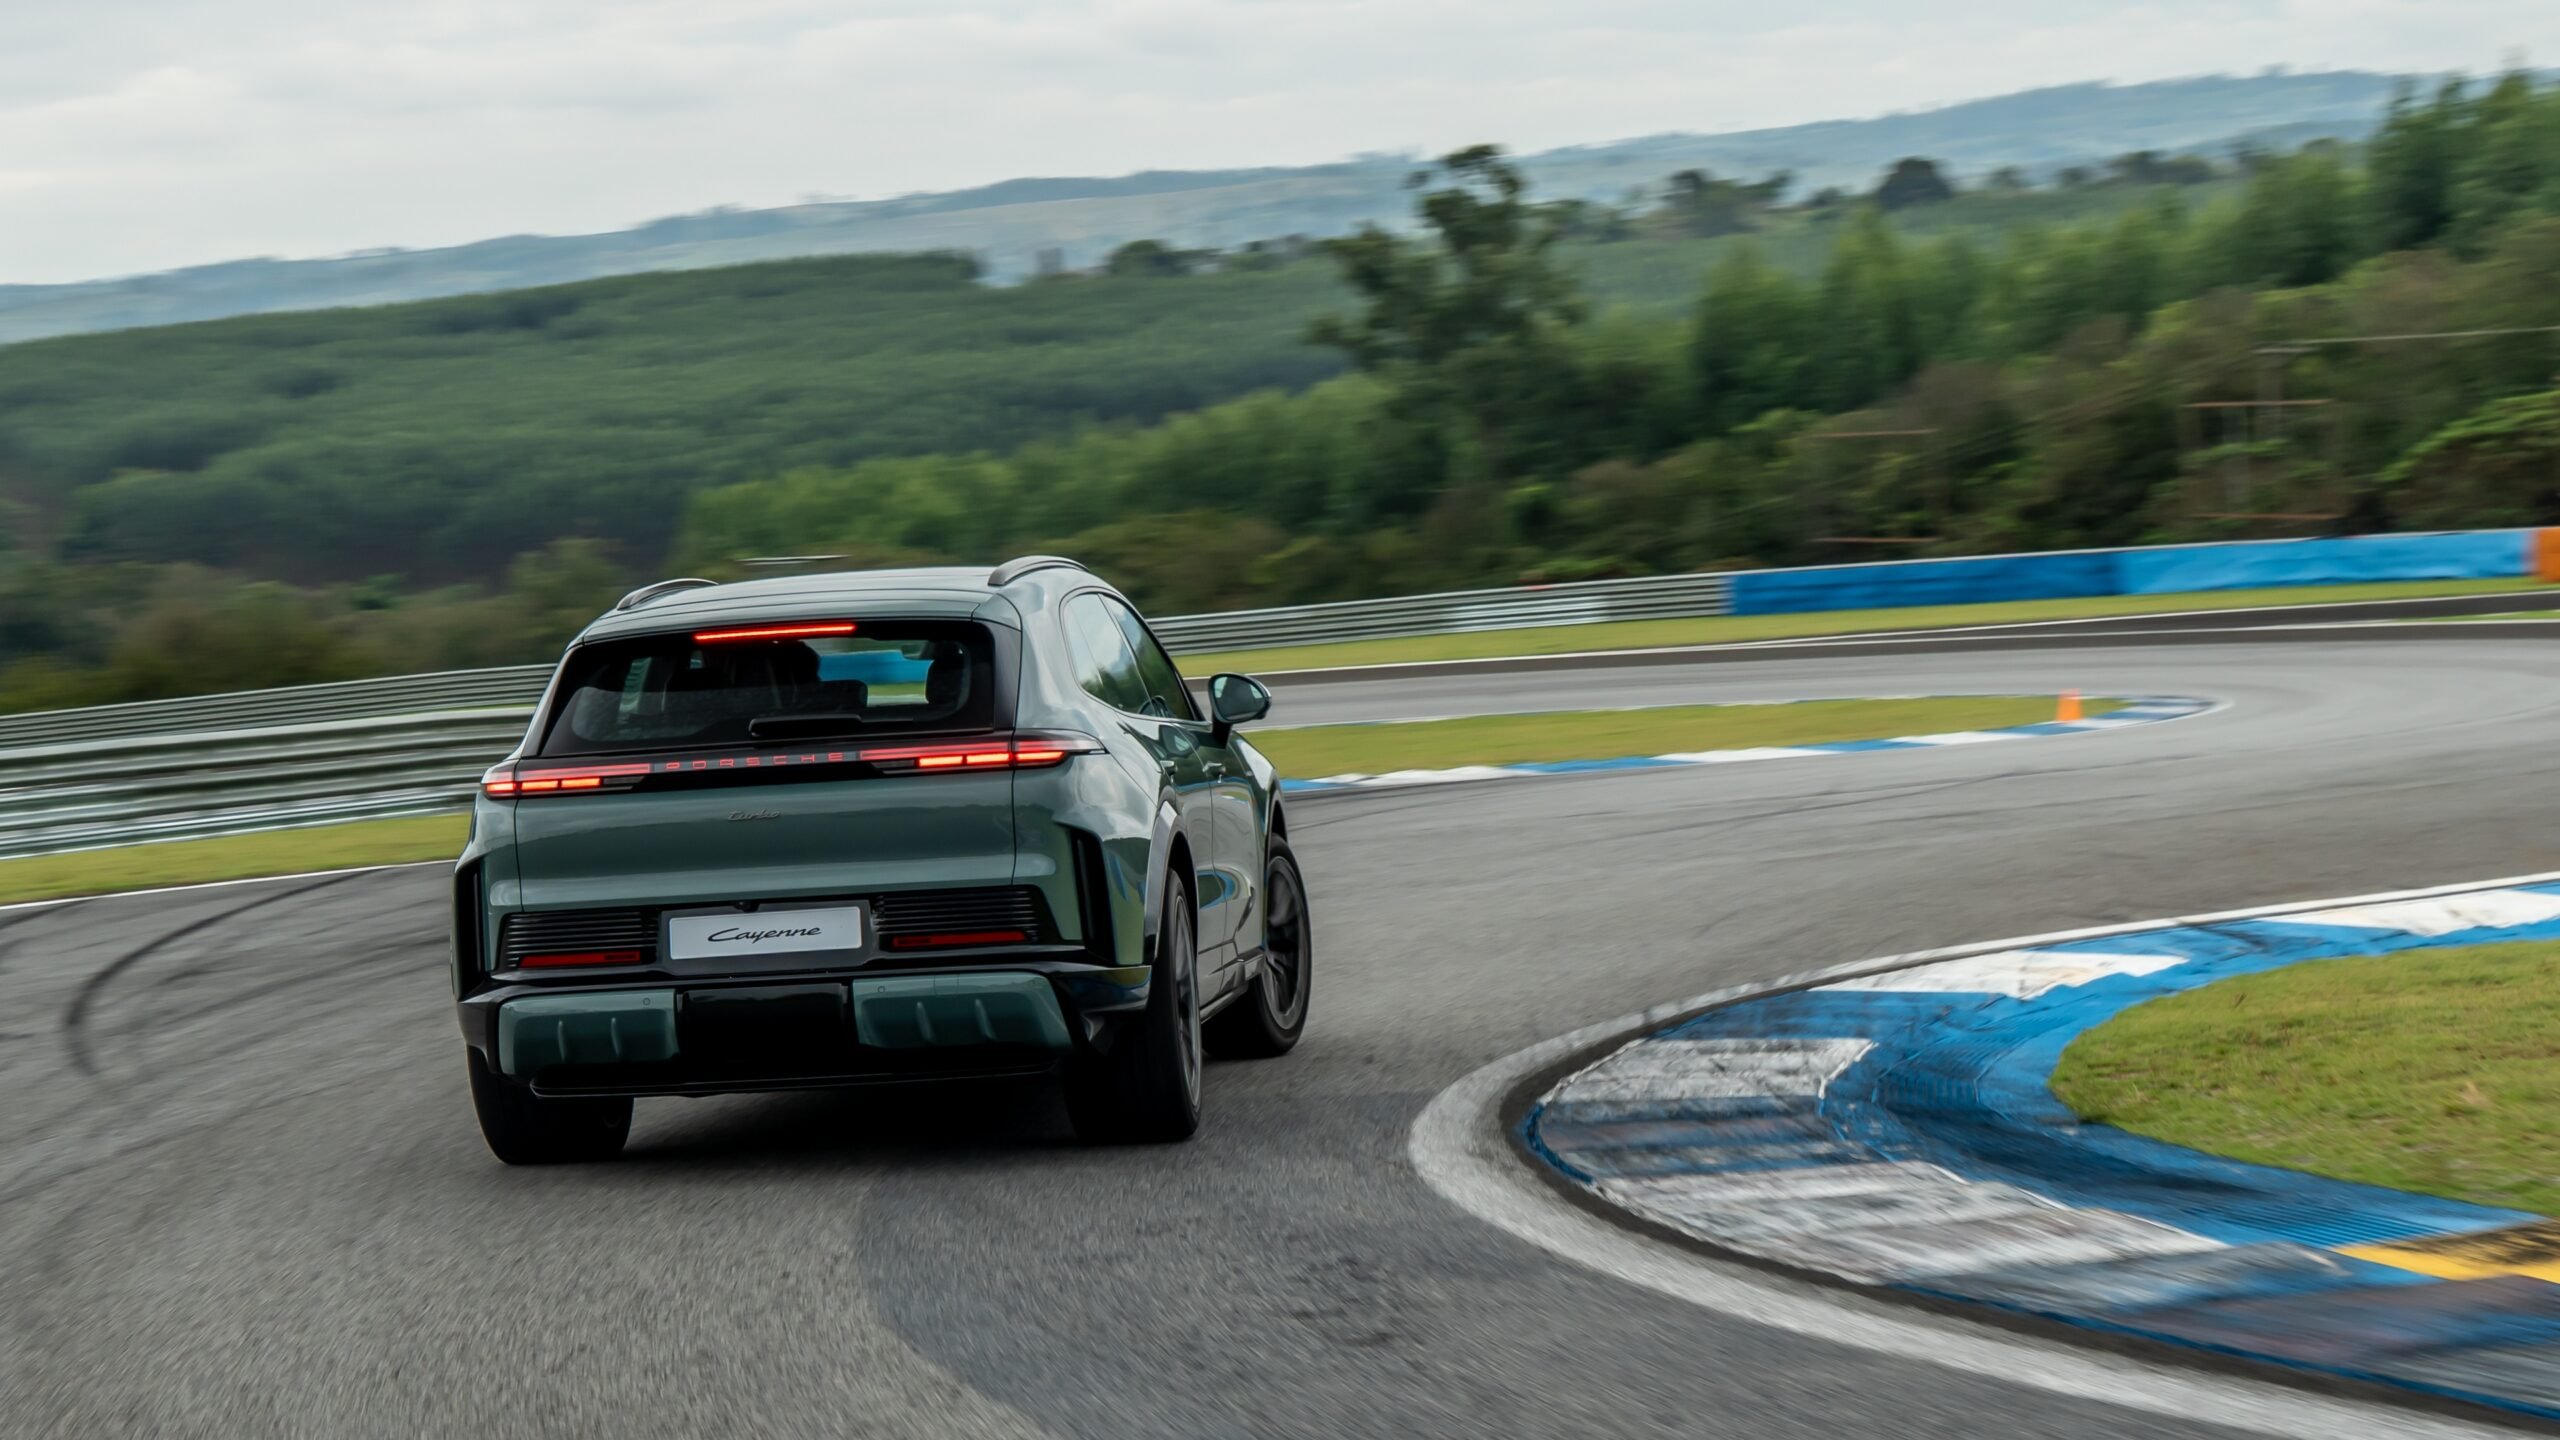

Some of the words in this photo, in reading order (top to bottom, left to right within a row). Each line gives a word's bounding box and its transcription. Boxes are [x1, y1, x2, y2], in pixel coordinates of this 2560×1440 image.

[665, 752, 844, 770] PORSCHE
[727, 809, 781, 821] turbo
[707, 926, 822, 944] Cayenne
